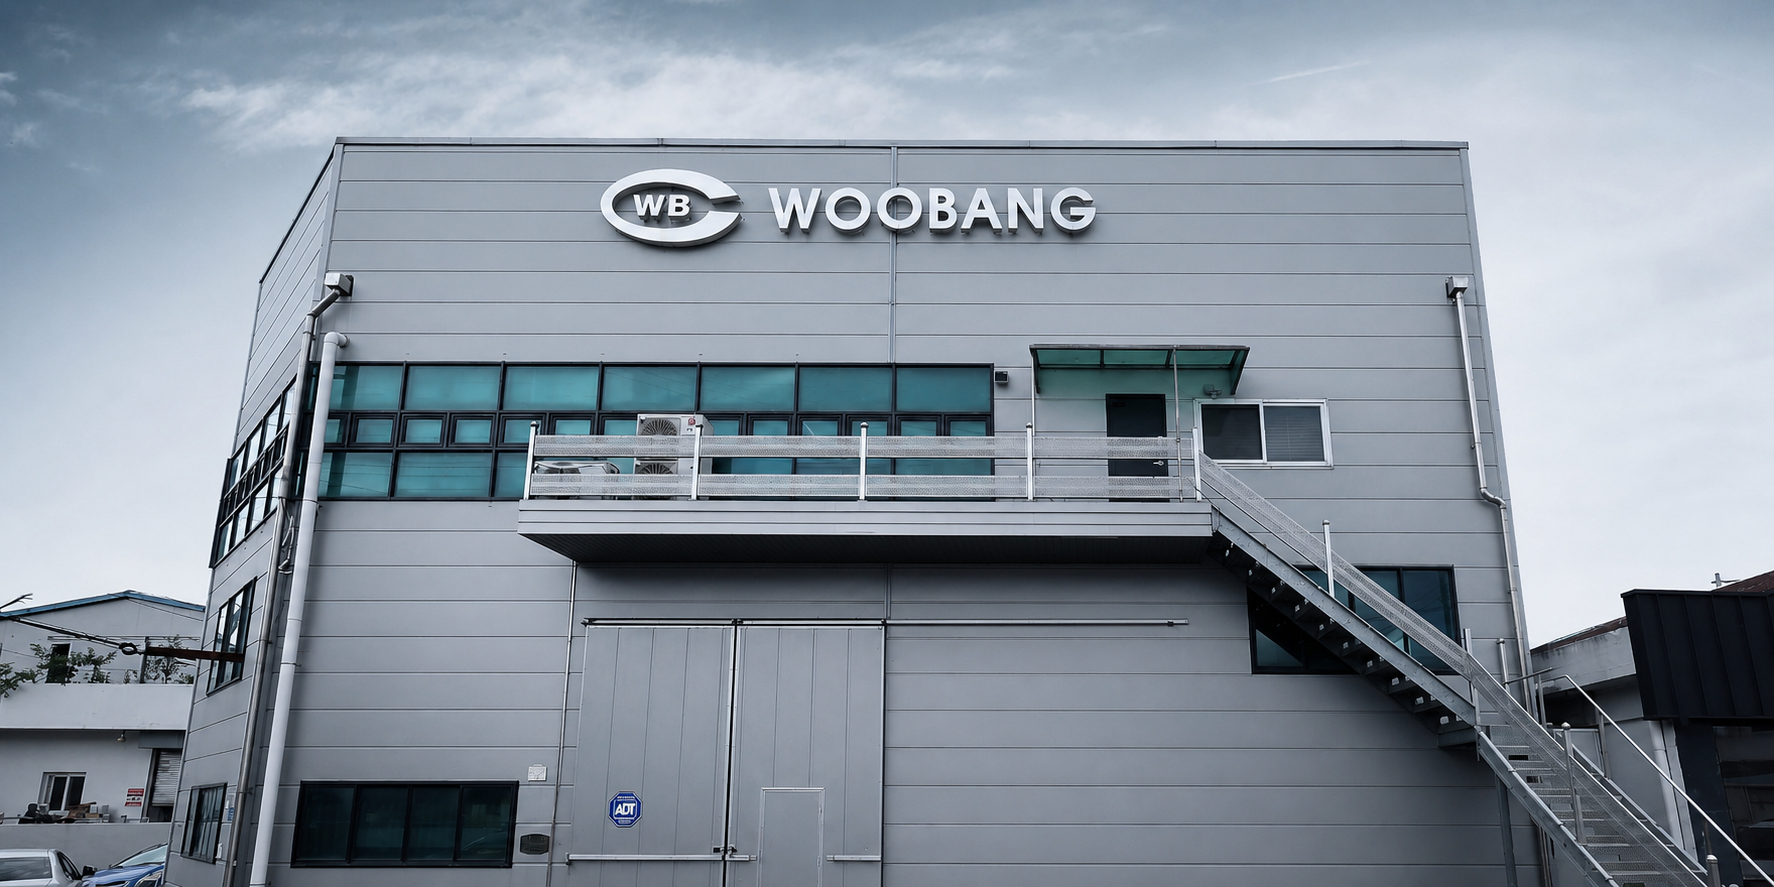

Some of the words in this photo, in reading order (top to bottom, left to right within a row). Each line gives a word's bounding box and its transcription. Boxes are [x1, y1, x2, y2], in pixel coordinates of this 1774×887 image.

[633, 194, 692, 221] WB
[768, 187, 1097, 233] WOOBANG
[615, 803, 636, 815] ADT
